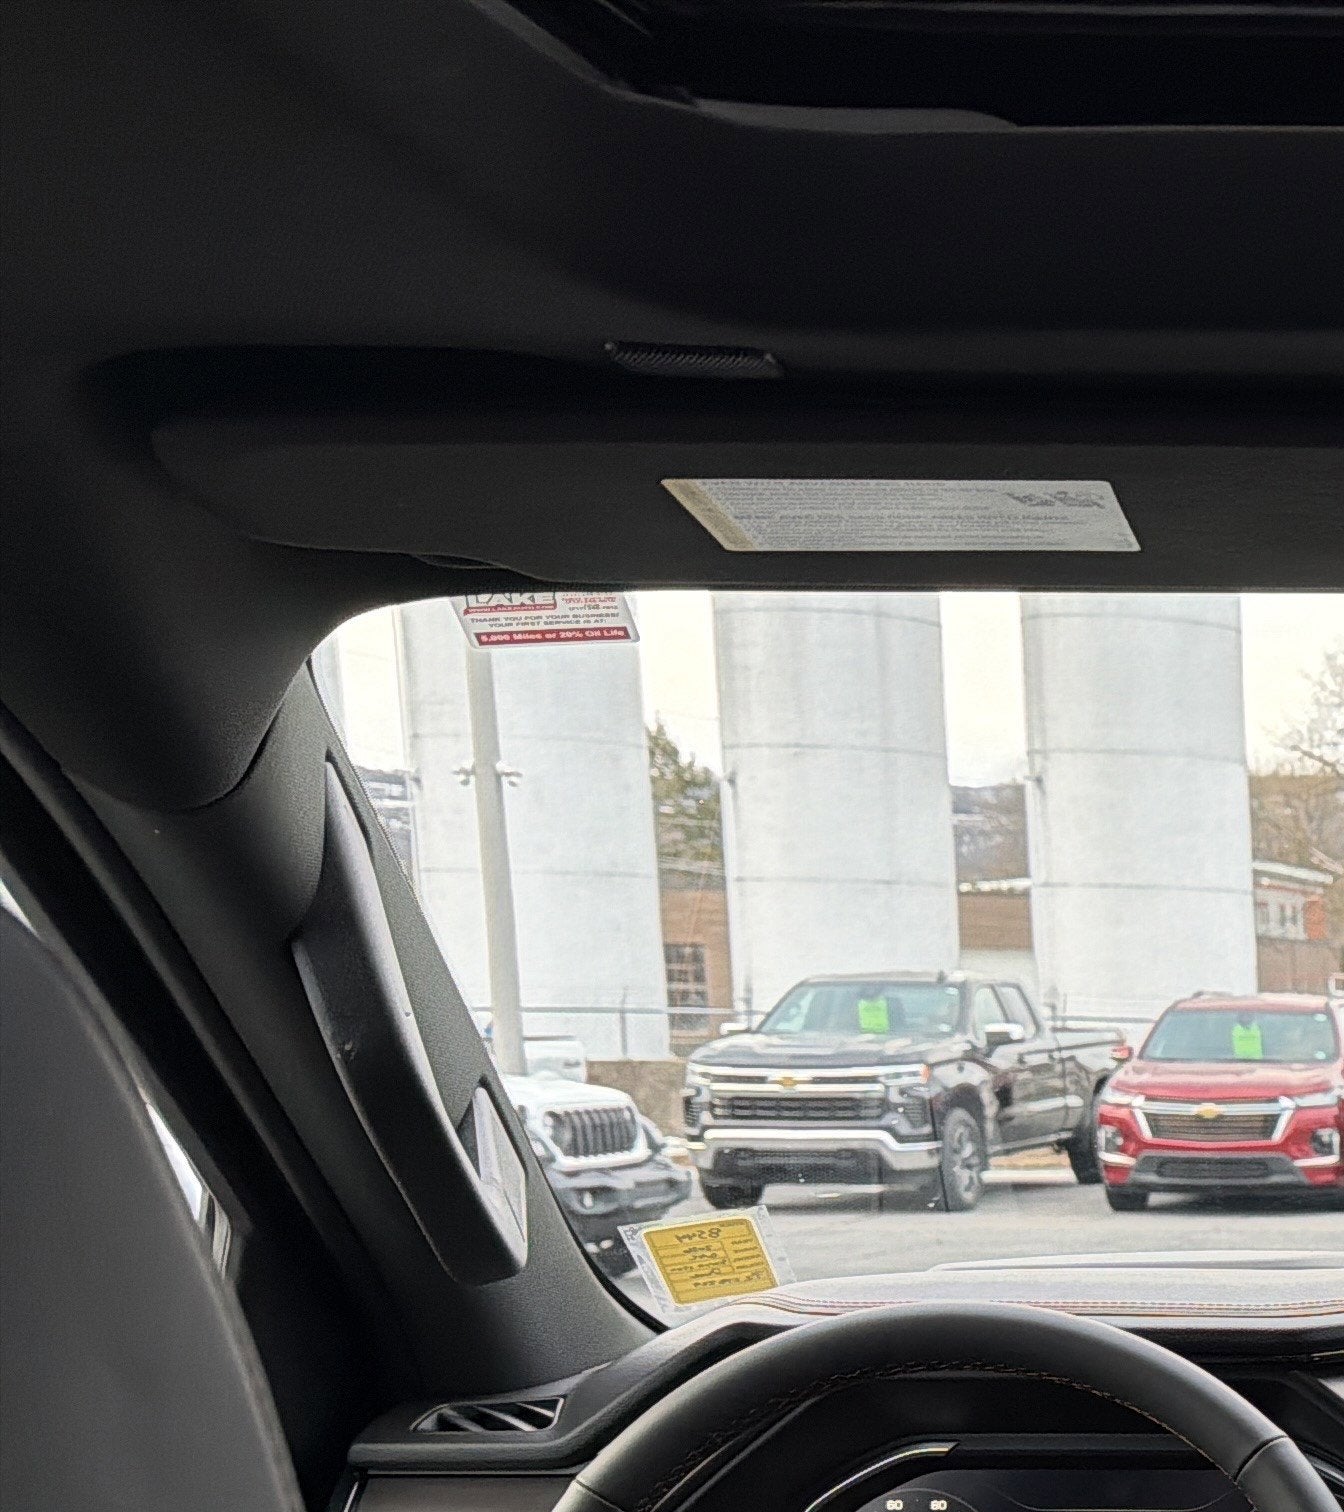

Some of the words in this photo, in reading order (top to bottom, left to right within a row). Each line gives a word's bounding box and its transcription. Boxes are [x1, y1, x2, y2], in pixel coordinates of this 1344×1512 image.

[512, 633, 542, 641] Miles
[559, 630, 583, 639] 20%
[886, 1500, 903, 1511] 60
[930, 1500, 947, 1511] 80
